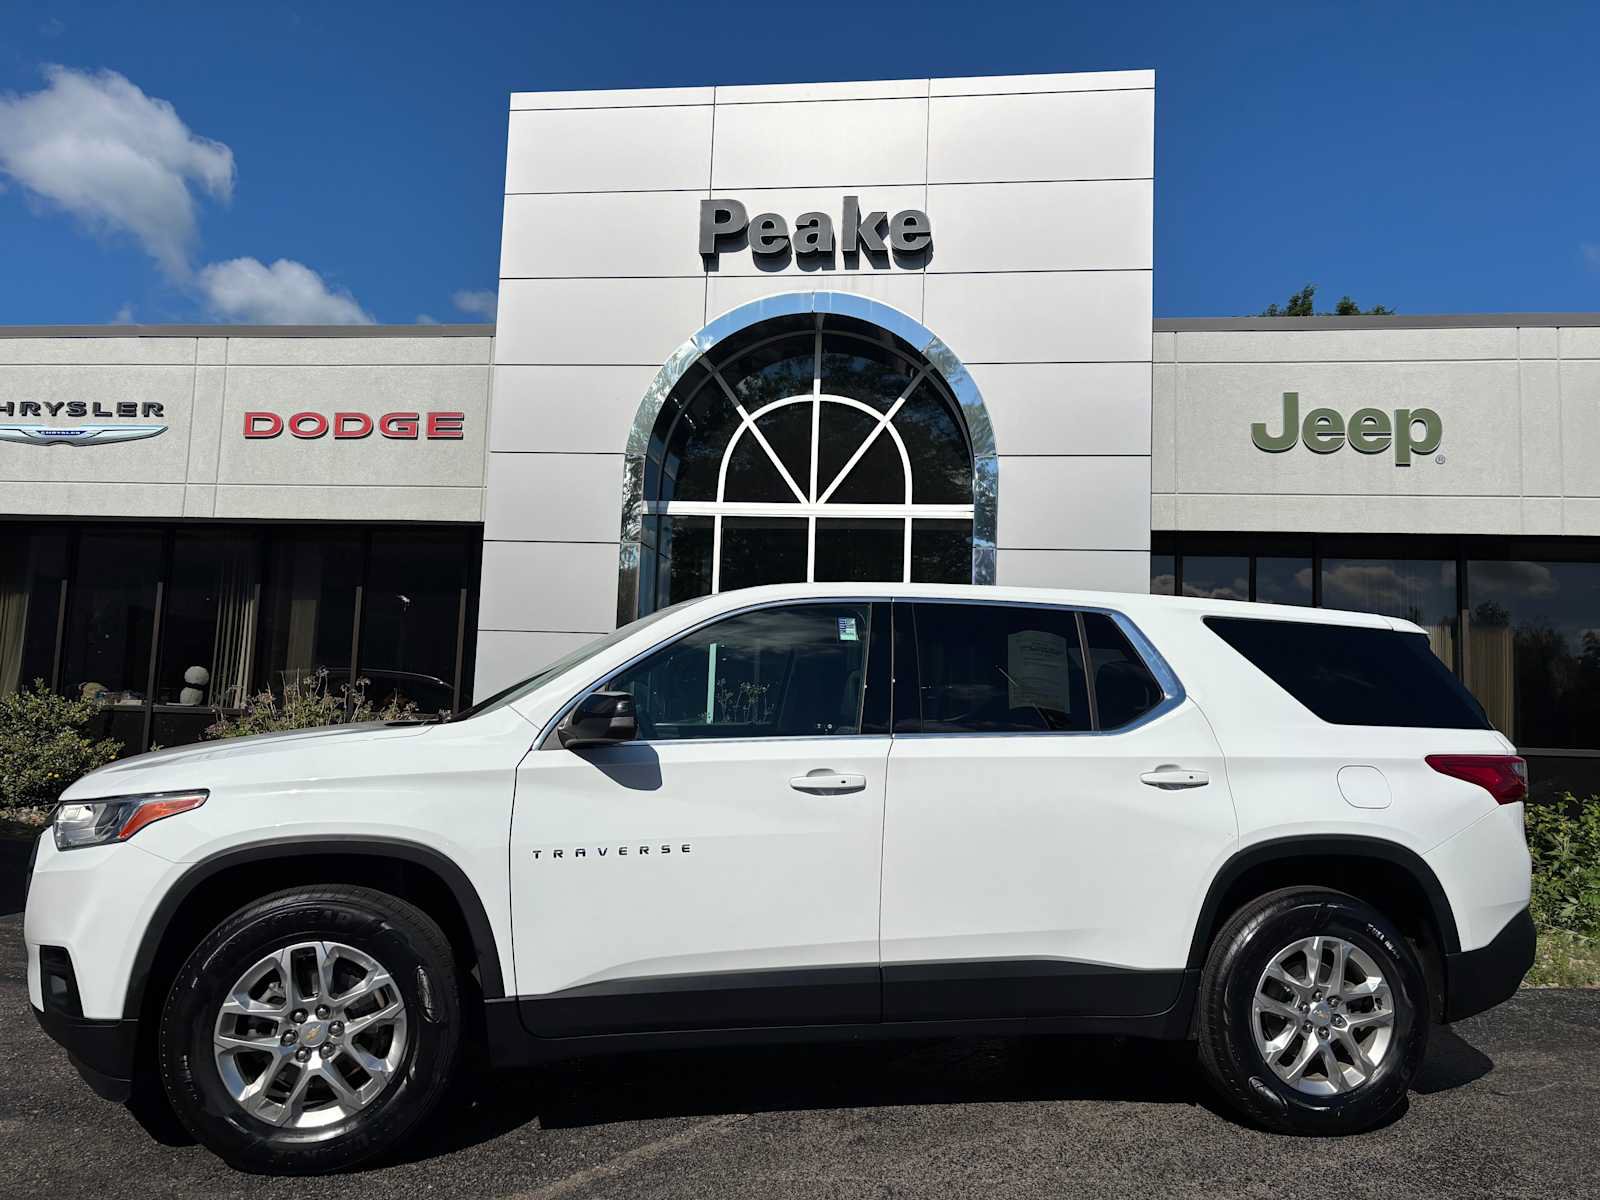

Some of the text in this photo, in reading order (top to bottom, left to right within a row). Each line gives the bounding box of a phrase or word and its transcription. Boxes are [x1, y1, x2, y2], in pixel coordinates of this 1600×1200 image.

[699, 196, 931, 257] Peake
[244, 411, 465, 440] DODGE
[1251, 392, 1443, 466] Jeep
[533, 844, 691, 859] TRAVERSE
